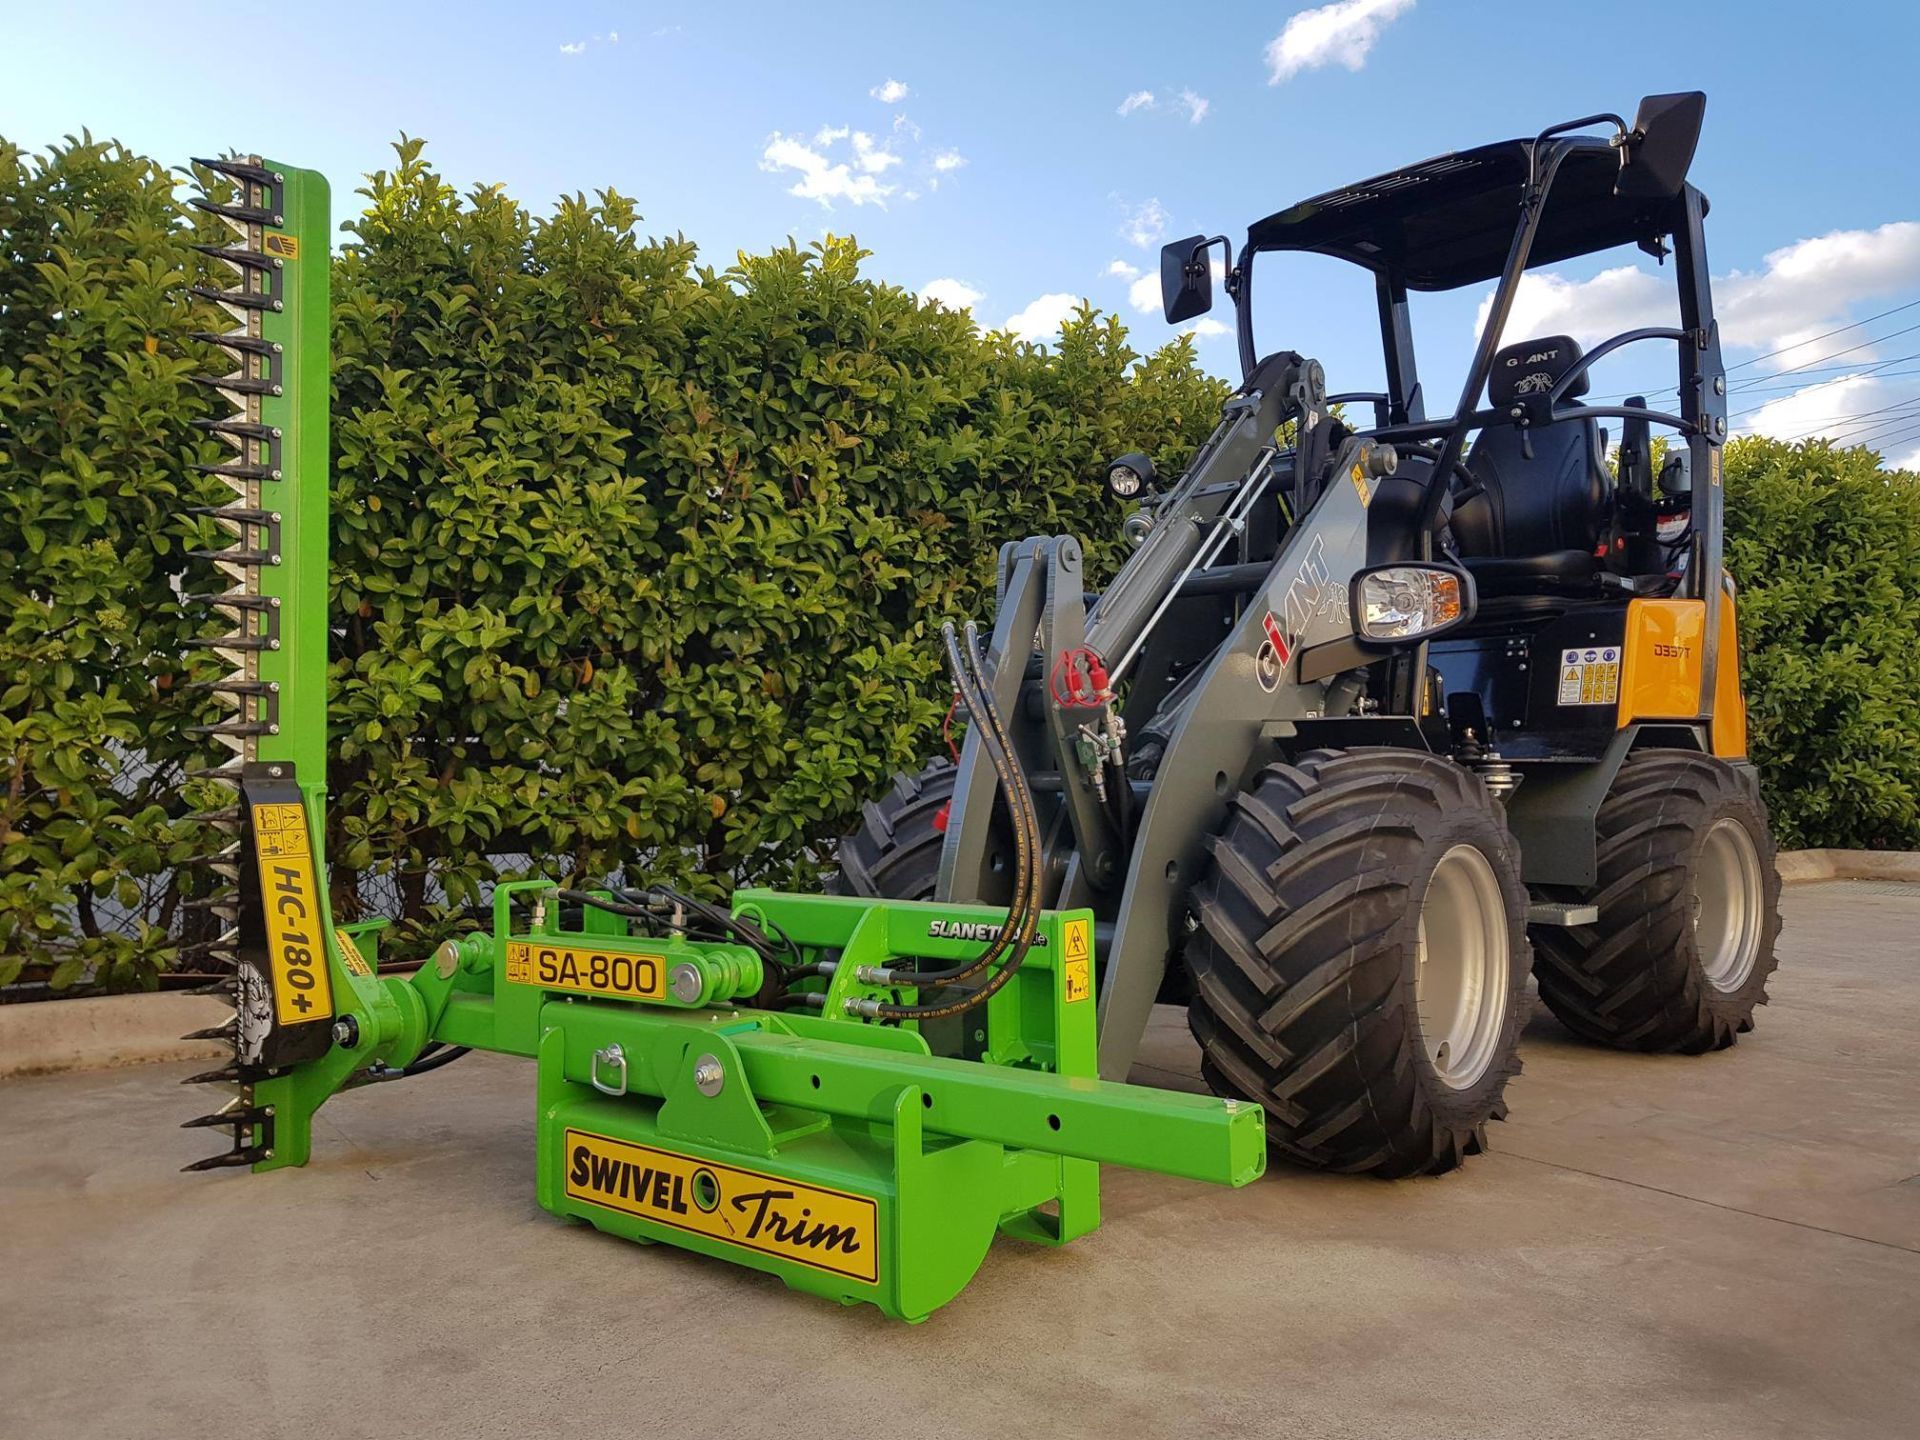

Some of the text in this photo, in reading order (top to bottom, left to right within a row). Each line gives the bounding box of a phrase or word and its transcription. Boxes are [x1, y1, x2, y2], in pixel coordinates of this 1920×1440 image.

[273, 865, 315, 1014] HC-180+
[539, 950, 657, 994] SA-800
[569, 1145, 861, 1254] SWIVEL Trim
